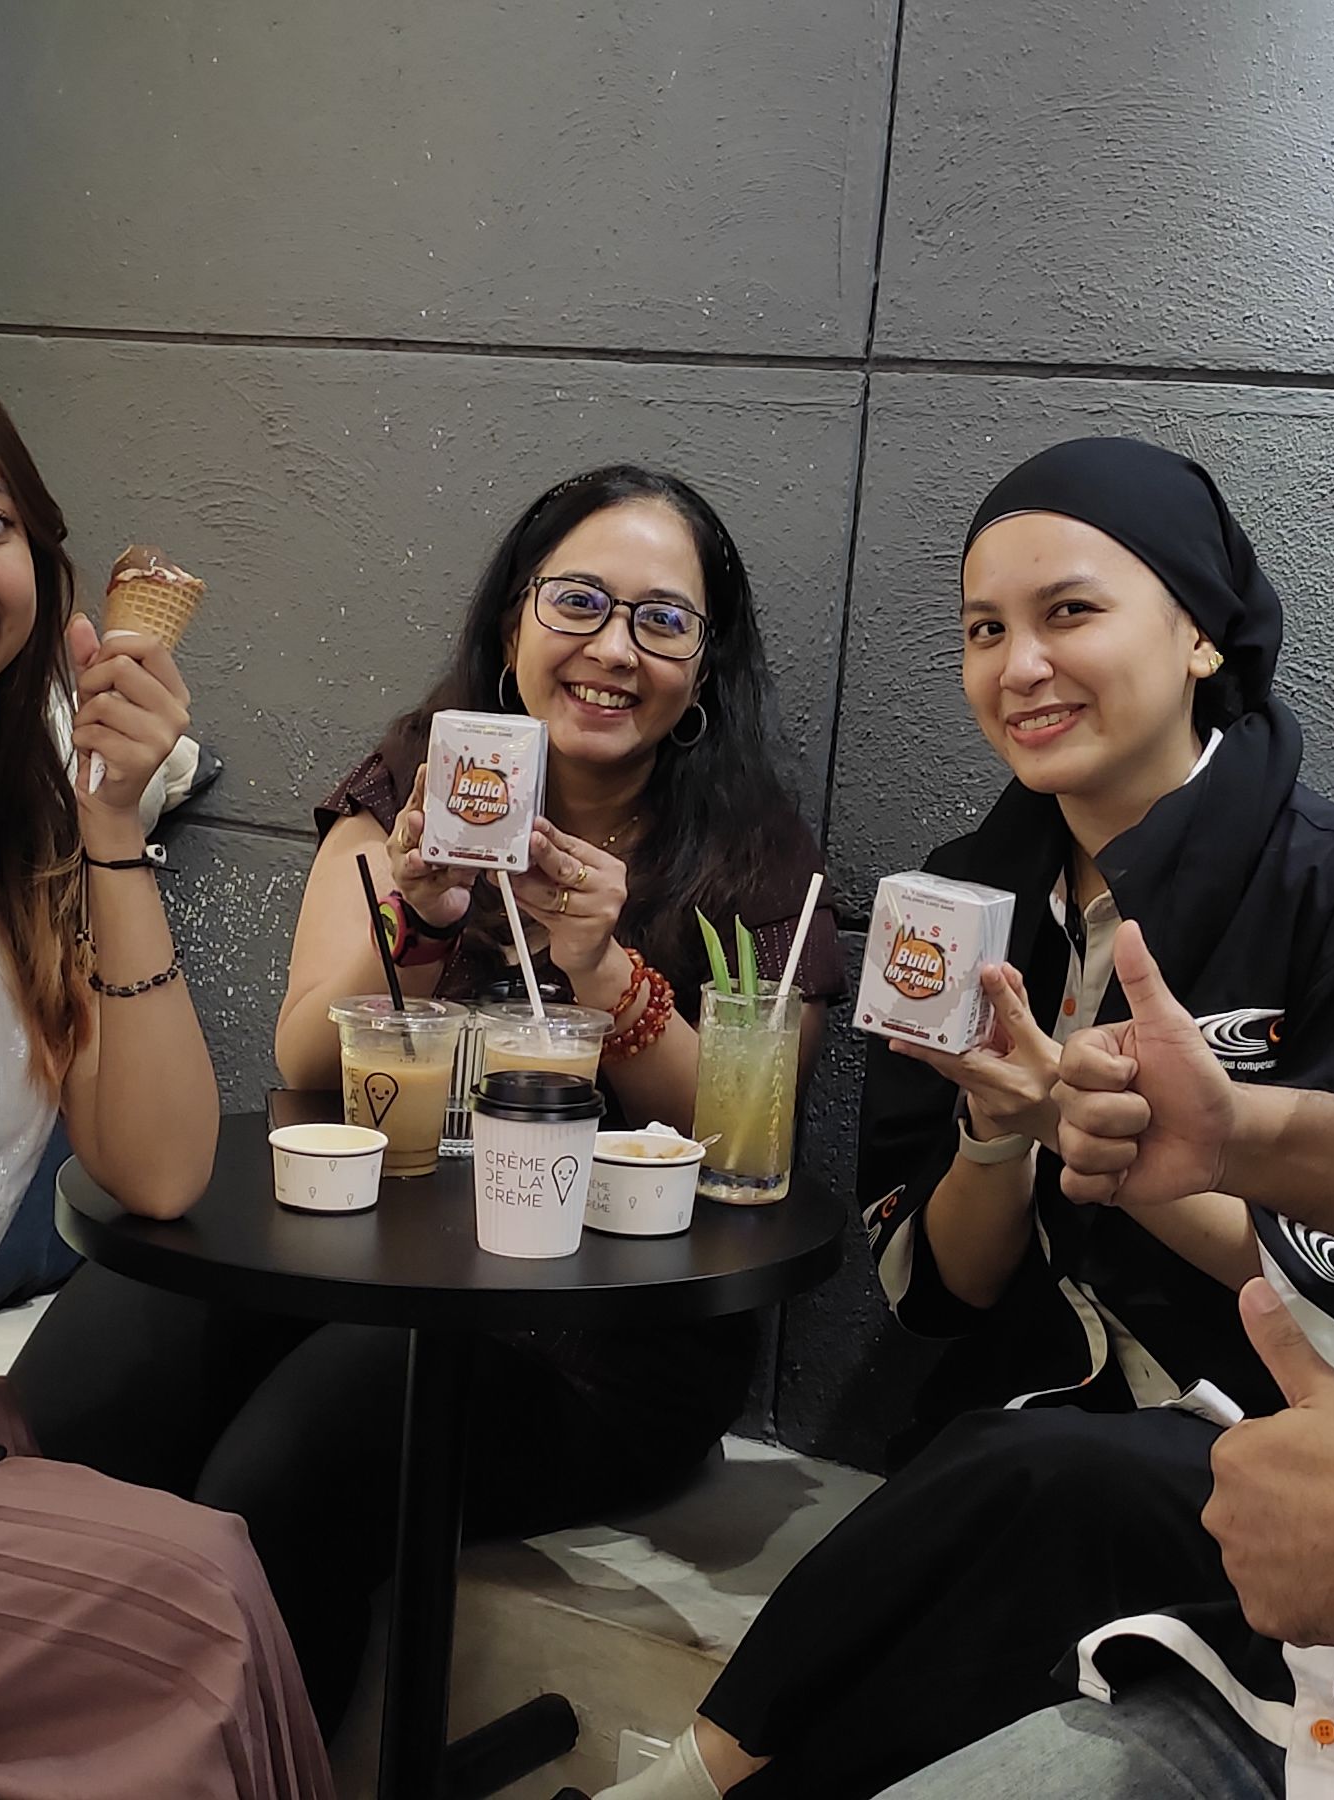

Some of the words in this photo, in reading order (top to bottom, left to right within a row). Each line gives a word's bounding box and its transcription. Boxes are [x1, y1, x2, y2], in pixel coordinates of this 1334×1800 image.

[457, 778, 505, 798] Build
[448, 795, 509, 815] My-Town
[896, 947, 942, 973] Build
[885, 964, 944, 991] My-Town
[485, 1149, 546, 1172] CRÈME
